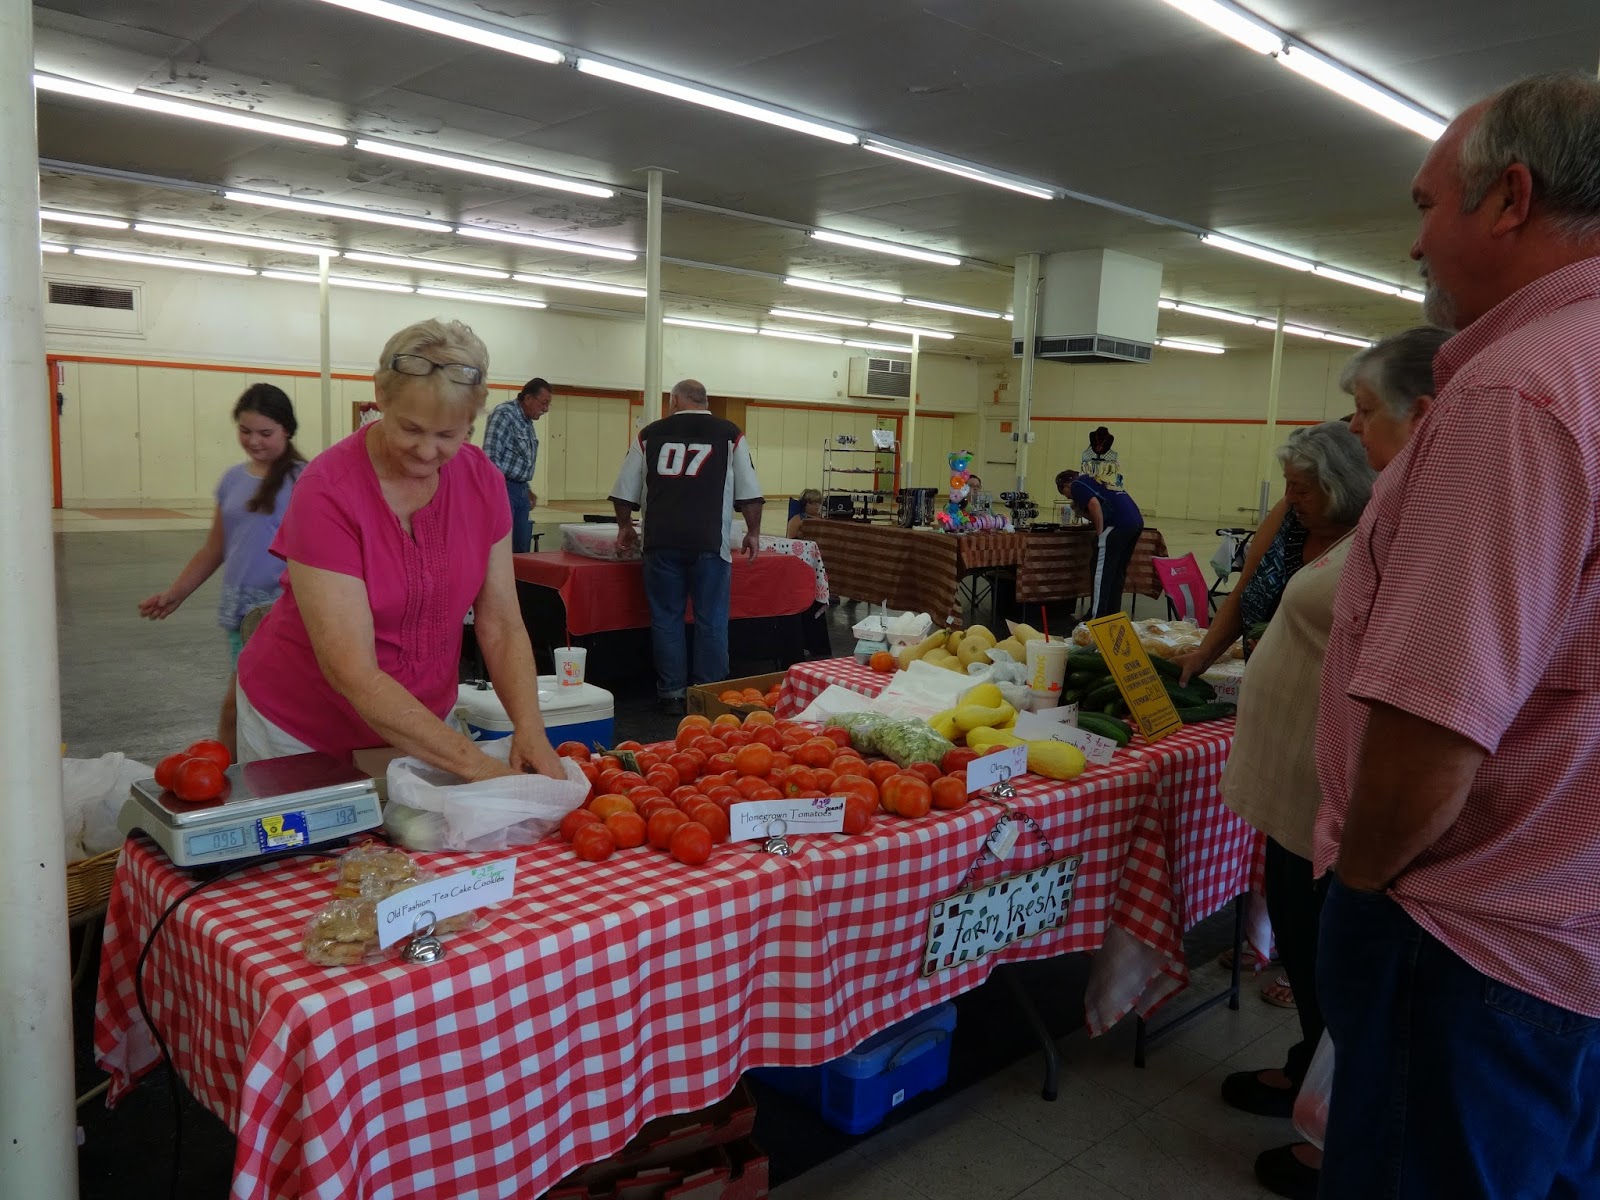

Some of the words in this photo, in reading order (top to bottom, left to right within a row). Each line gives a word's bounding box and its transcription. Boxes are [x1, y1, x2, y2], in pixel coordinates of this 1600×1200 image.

[998, 383, 1008, 391] EXIT
[657, 443, 713, 477] 07
[1123, 659, 1141, 672] SENIOR
[1085, 733, 1092, 744] 3
[790, 809, 832, 819] Tomatoes
[825, 802, 843, 814] pound
[386, 907, 401, 924] Old
[402, 899, 430, 917] Fashion
[432, 893, 449, 904] Tea
[450, 886, 472, 898] Cake
[473, 874, 505, 891] Cookies
